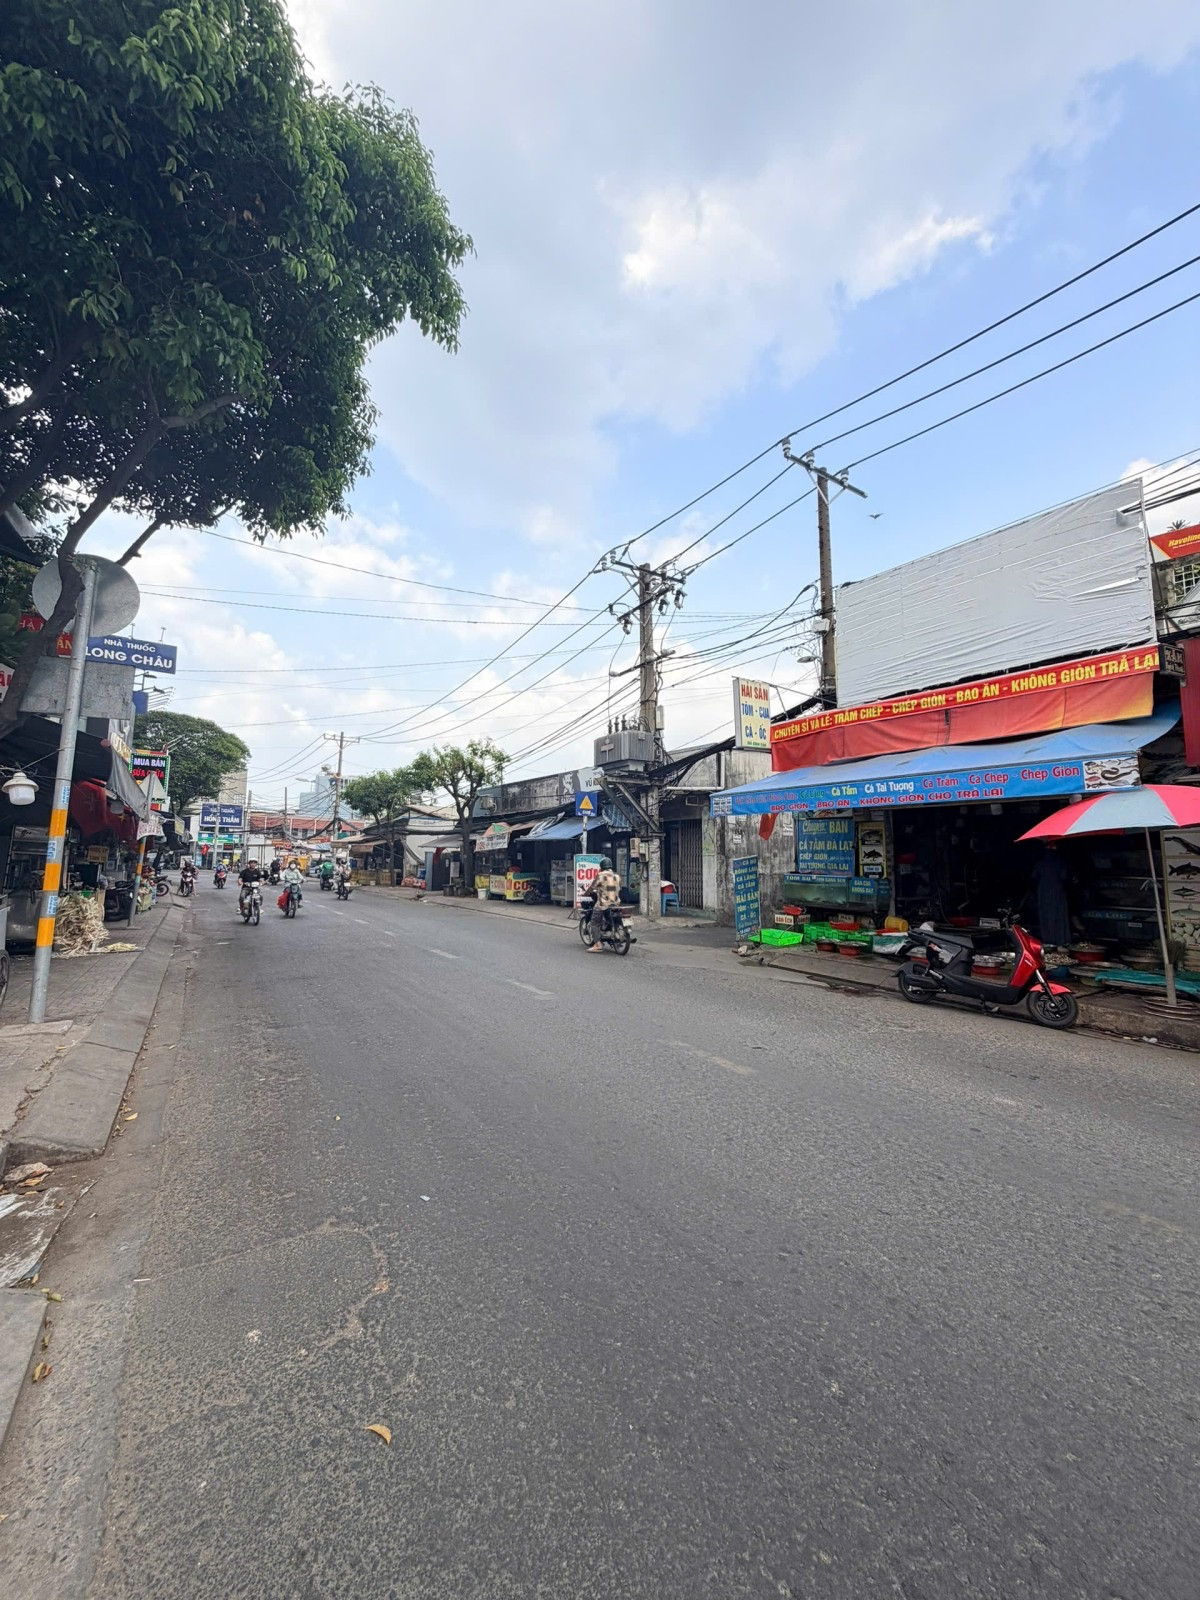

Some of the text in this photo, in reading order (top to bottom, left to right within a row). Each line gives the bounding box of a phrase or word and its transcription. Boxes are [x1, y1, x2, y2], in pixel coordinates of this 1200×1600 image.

[104, 637, 156, 653] NHÀ THUỐC
[86, 647, 173, 669] LONG CHÂU
[921, 692, 946, 709] GIÒN
[956, 688, 979, 703] BAO
[982, 681, 1000, 698] ĂN
[1012, 674, 1057, 693] KHÔNG
[1061, 665, 1096, 685] GIÒN
[1100, 654, 1130, 676] TRẢ
[741, 681, 769, 701] HẢI SẢN
[742, 701, 754, 716] TÔM
[745, 723, 767, 740] CÁ ỐC
[133, 756, 165, 767] MUA BÁN
[831, 786, 840, 796] Cá
[865, 783, 874, 793] Cá
[876, 782, 887, 792] Tai
[984, 772, 1009, 785] Chép
[1021, 768, 1048, 782] Chép
[771, 804, 786, 812] BAO
[817, 800, 835, 809] BAO
[860, 796, 894, 806] KHÔNG
[928, 789, 952, 801] CHO
[799, 839, 808, 850] CÁ
[827, 840, 837, 850] ĐÀ
[840, 841, 853, 853] LẠT
